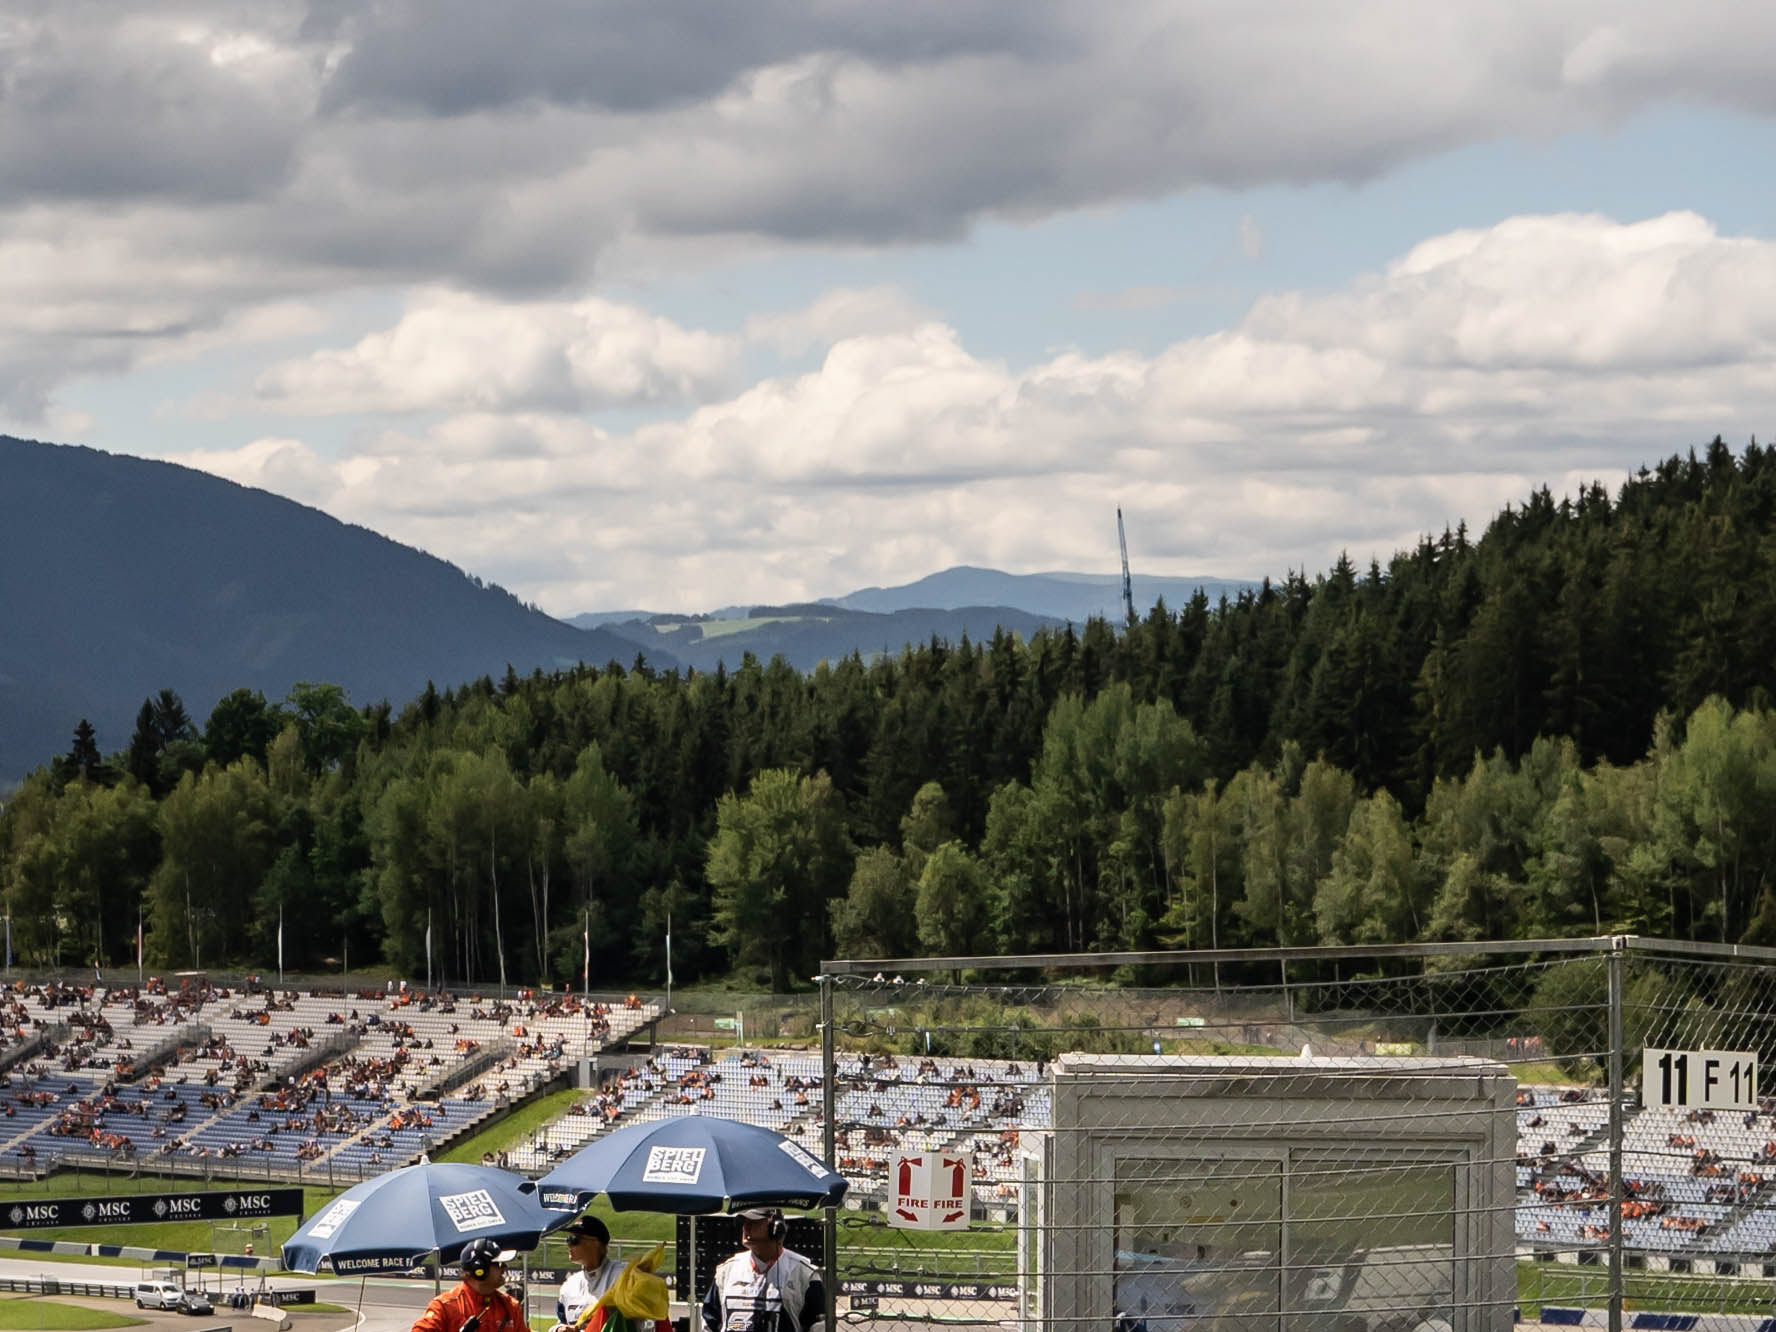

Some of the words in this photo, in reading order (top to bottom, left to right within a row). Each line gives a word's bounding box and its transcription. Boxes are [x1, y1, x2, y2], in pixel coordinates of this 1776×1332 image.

[1659, 1054, 1688, 1105] 11
[1705, 1060, 1719, 1102] F
[1730, 1061, 1753, 1104] 11
[651, 1149, 702, 1161] SPIEL
[651, 1160, 695, 1173] BERG
[170, 1199, 201, 1213] MSC
[240, 1196, 271, 1209] MSC
[445, 1192, 490, 1209] SPIEL
[898, 1198, 928, 1208] FIRE
[934, 1200, 963, 1208] FIRE
[26, 1205, 59, 1220] MSC
[98, 1202, 130, 1216] MSC
[451, 1202, 494, 1220] BERG
[338, 1259, 380, 1269] WELCOME
[383, 1258, 404, 1267] RACE
[443, 1267, 459, 1276] MSC
[539, 1271, 555, 1280] MSC
[850, 1282, 867, 1291] MSC
[886, 1284, 903, 1293] MSC
[923, 1285, 941, 1295] MSC
[960, 1286, 978, 1295] MSC
[997, 1287, 1016, 1297] MSC
